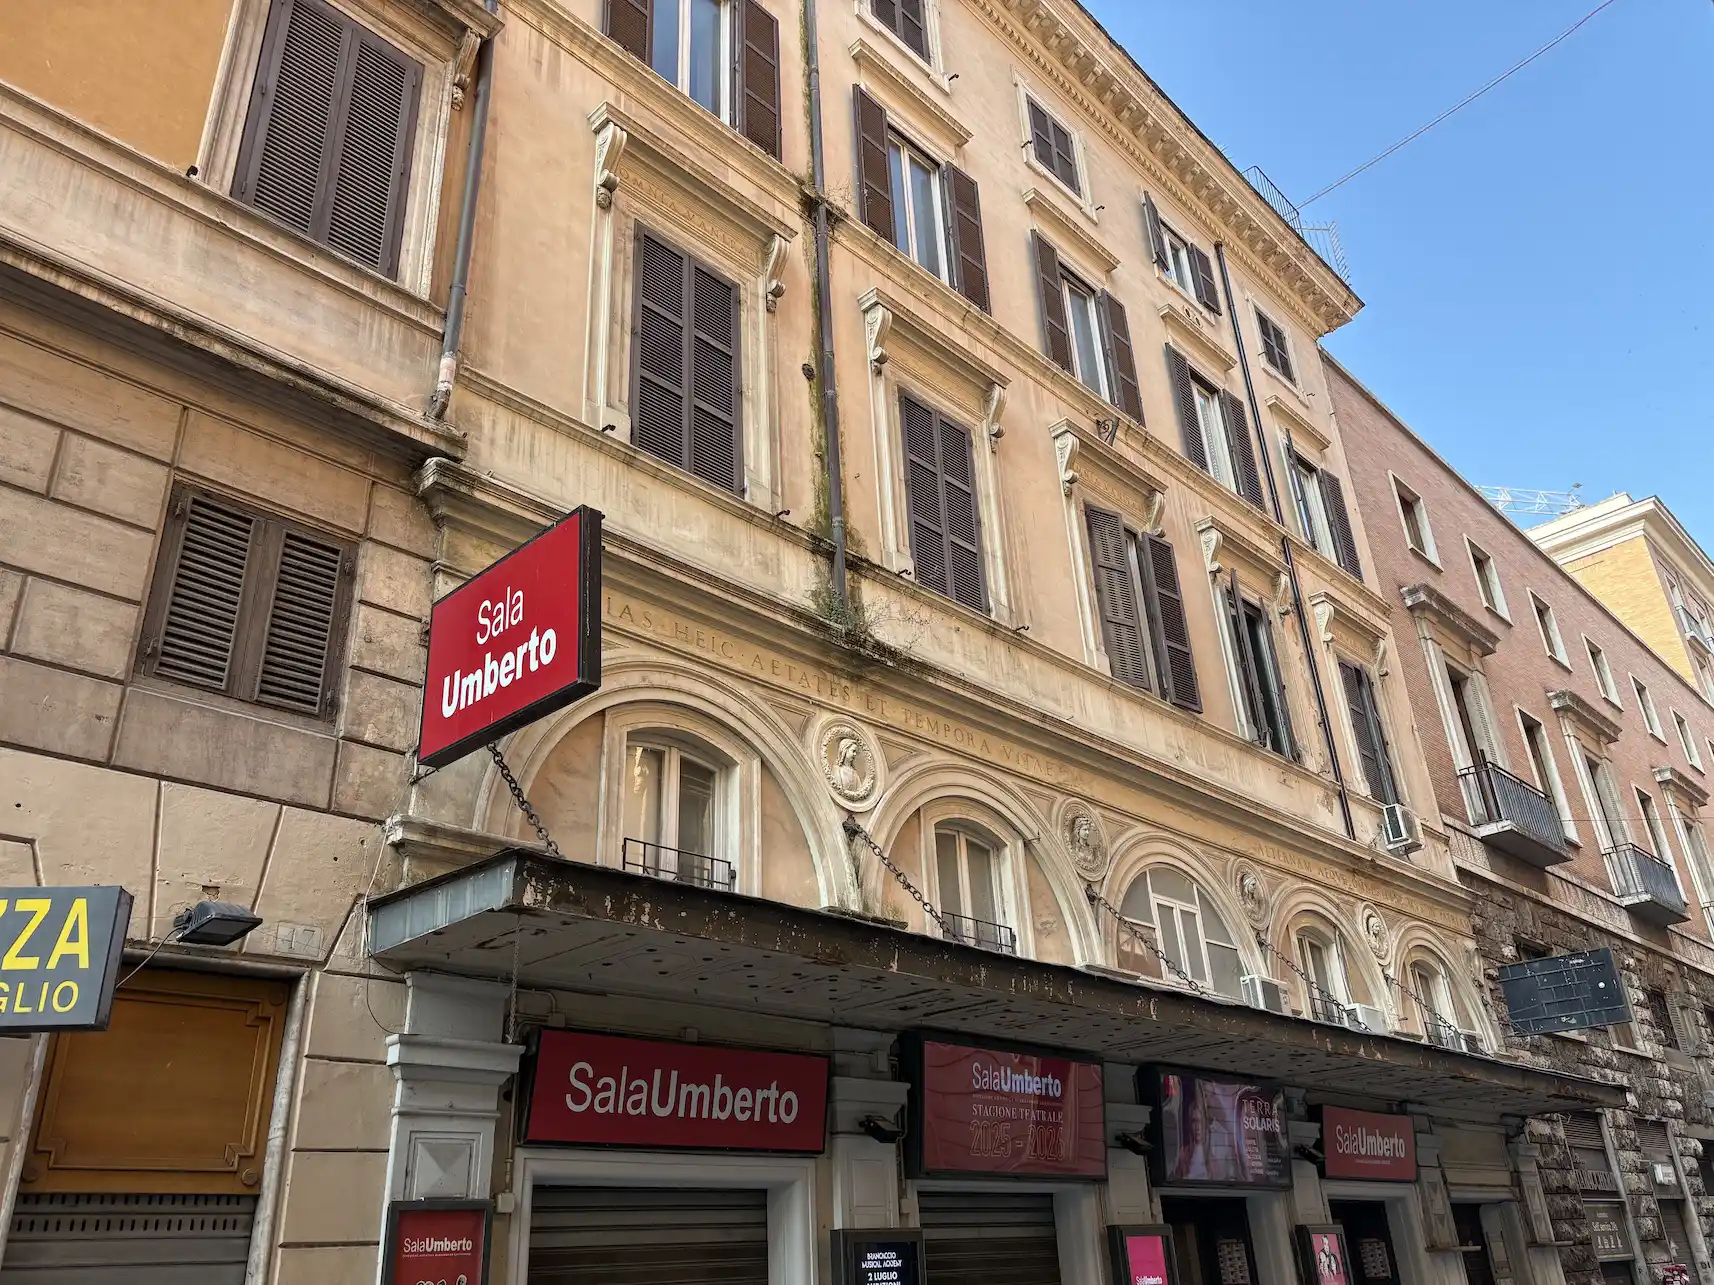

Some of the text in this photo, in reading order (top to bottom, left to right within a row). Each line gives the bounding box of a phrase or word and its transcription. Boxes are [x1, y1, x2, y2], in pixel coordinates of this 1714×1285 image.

[619, 166, 678, 208] OMNIA
[476, 586, 524, 645] Sala
[441, 625, 557, 718] Umberto
[673, 621, 736, 660] HEIC
[751, 653, 850, 702] AETATES
[865, 693, 888, 715] ET
[902, 708, 992, 754] TEMPORA
[0, 897, 90, 970] ZA
[565, 1061, 799, 1124] SalaUmberto
[972, 1061, 1062, 1097] SalaUmberto
[972, 1104, 1064, 1123] STAGIONE TEATRALE
[1242, 1099, 1278, 1116] TERRA
[1243, 1115, 1280, 1133] SOLARIS
[969, 1119, 1012, 1158] 2025
[1028, 1124, 1065, 1160] 2026
[1336, 1124, 1406, 1159] SalaUmberto
[403, 1237, 473, 1253] SalaUmberto
[867, 1271, 898, 1281] 2 LUGLIO
